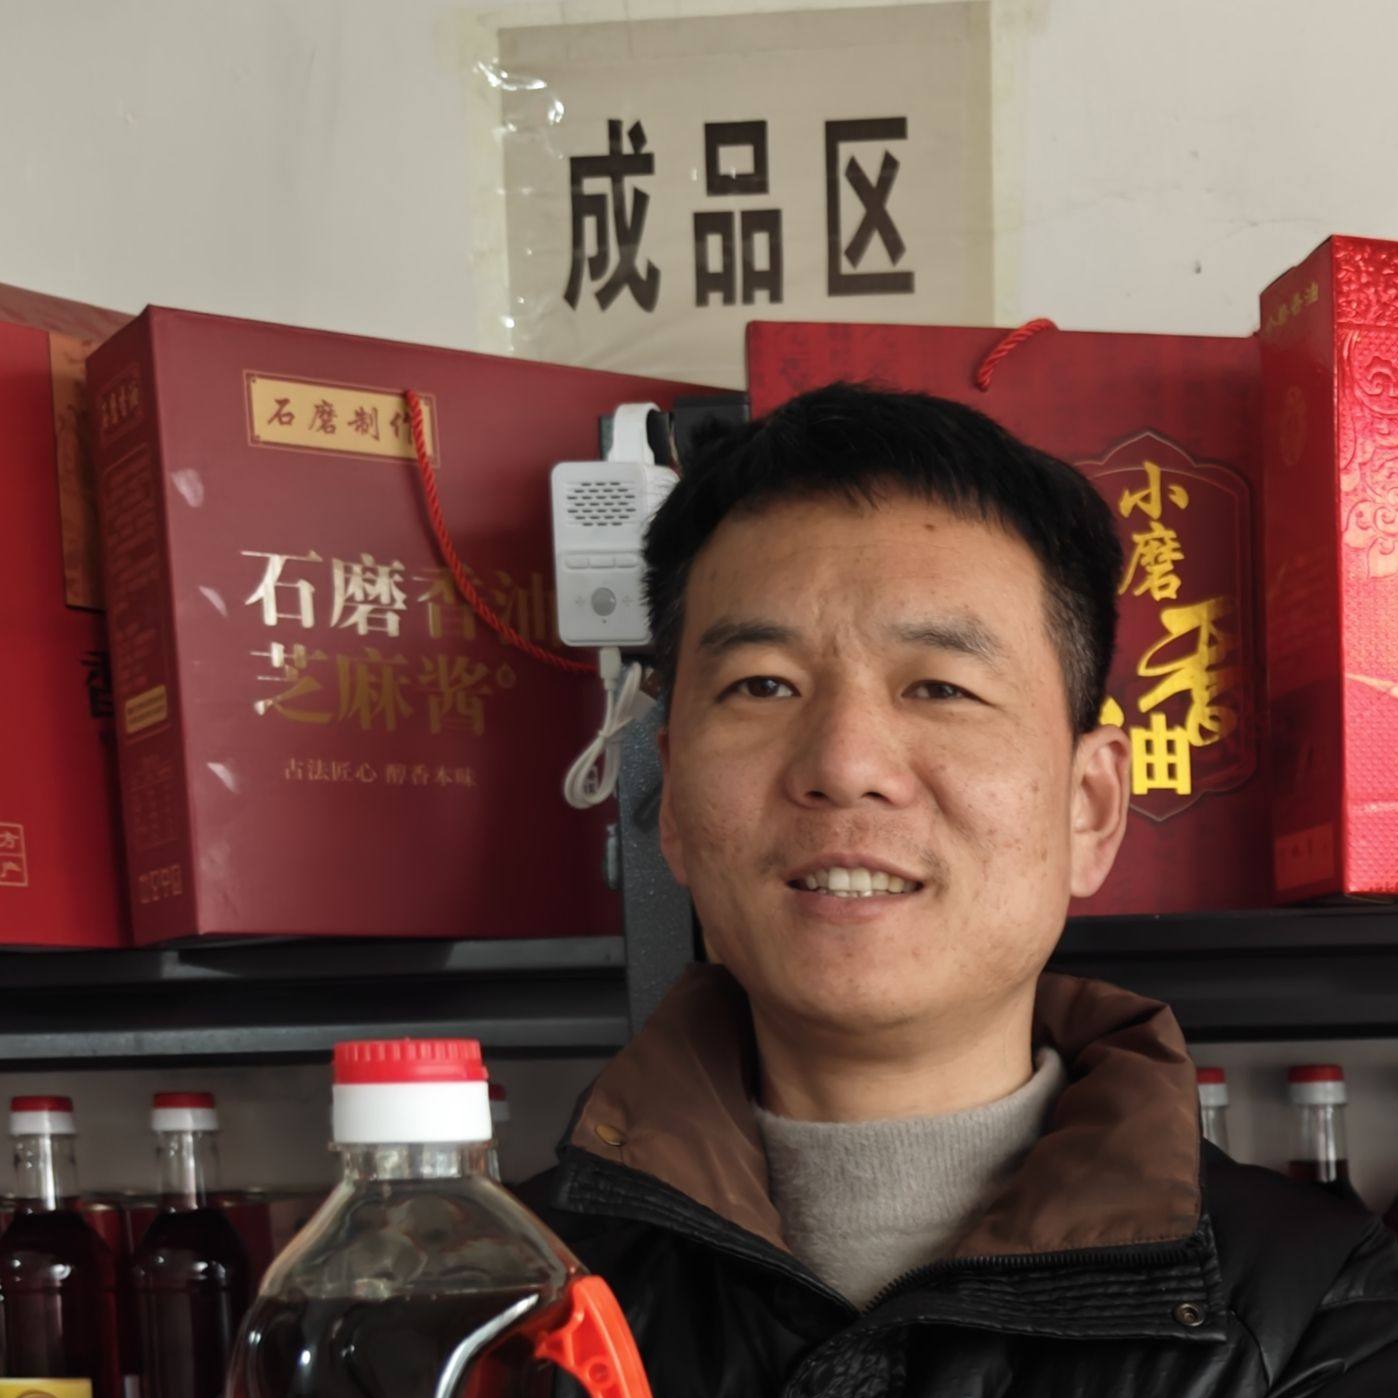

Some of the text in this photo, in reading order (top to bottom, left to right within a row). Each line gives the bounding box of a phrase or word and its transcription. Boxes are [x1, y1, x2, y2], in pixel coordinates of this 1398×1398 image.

[563, 117, 915, 313] 成品区
[250, 641, 493, 736] 芝麻酱
